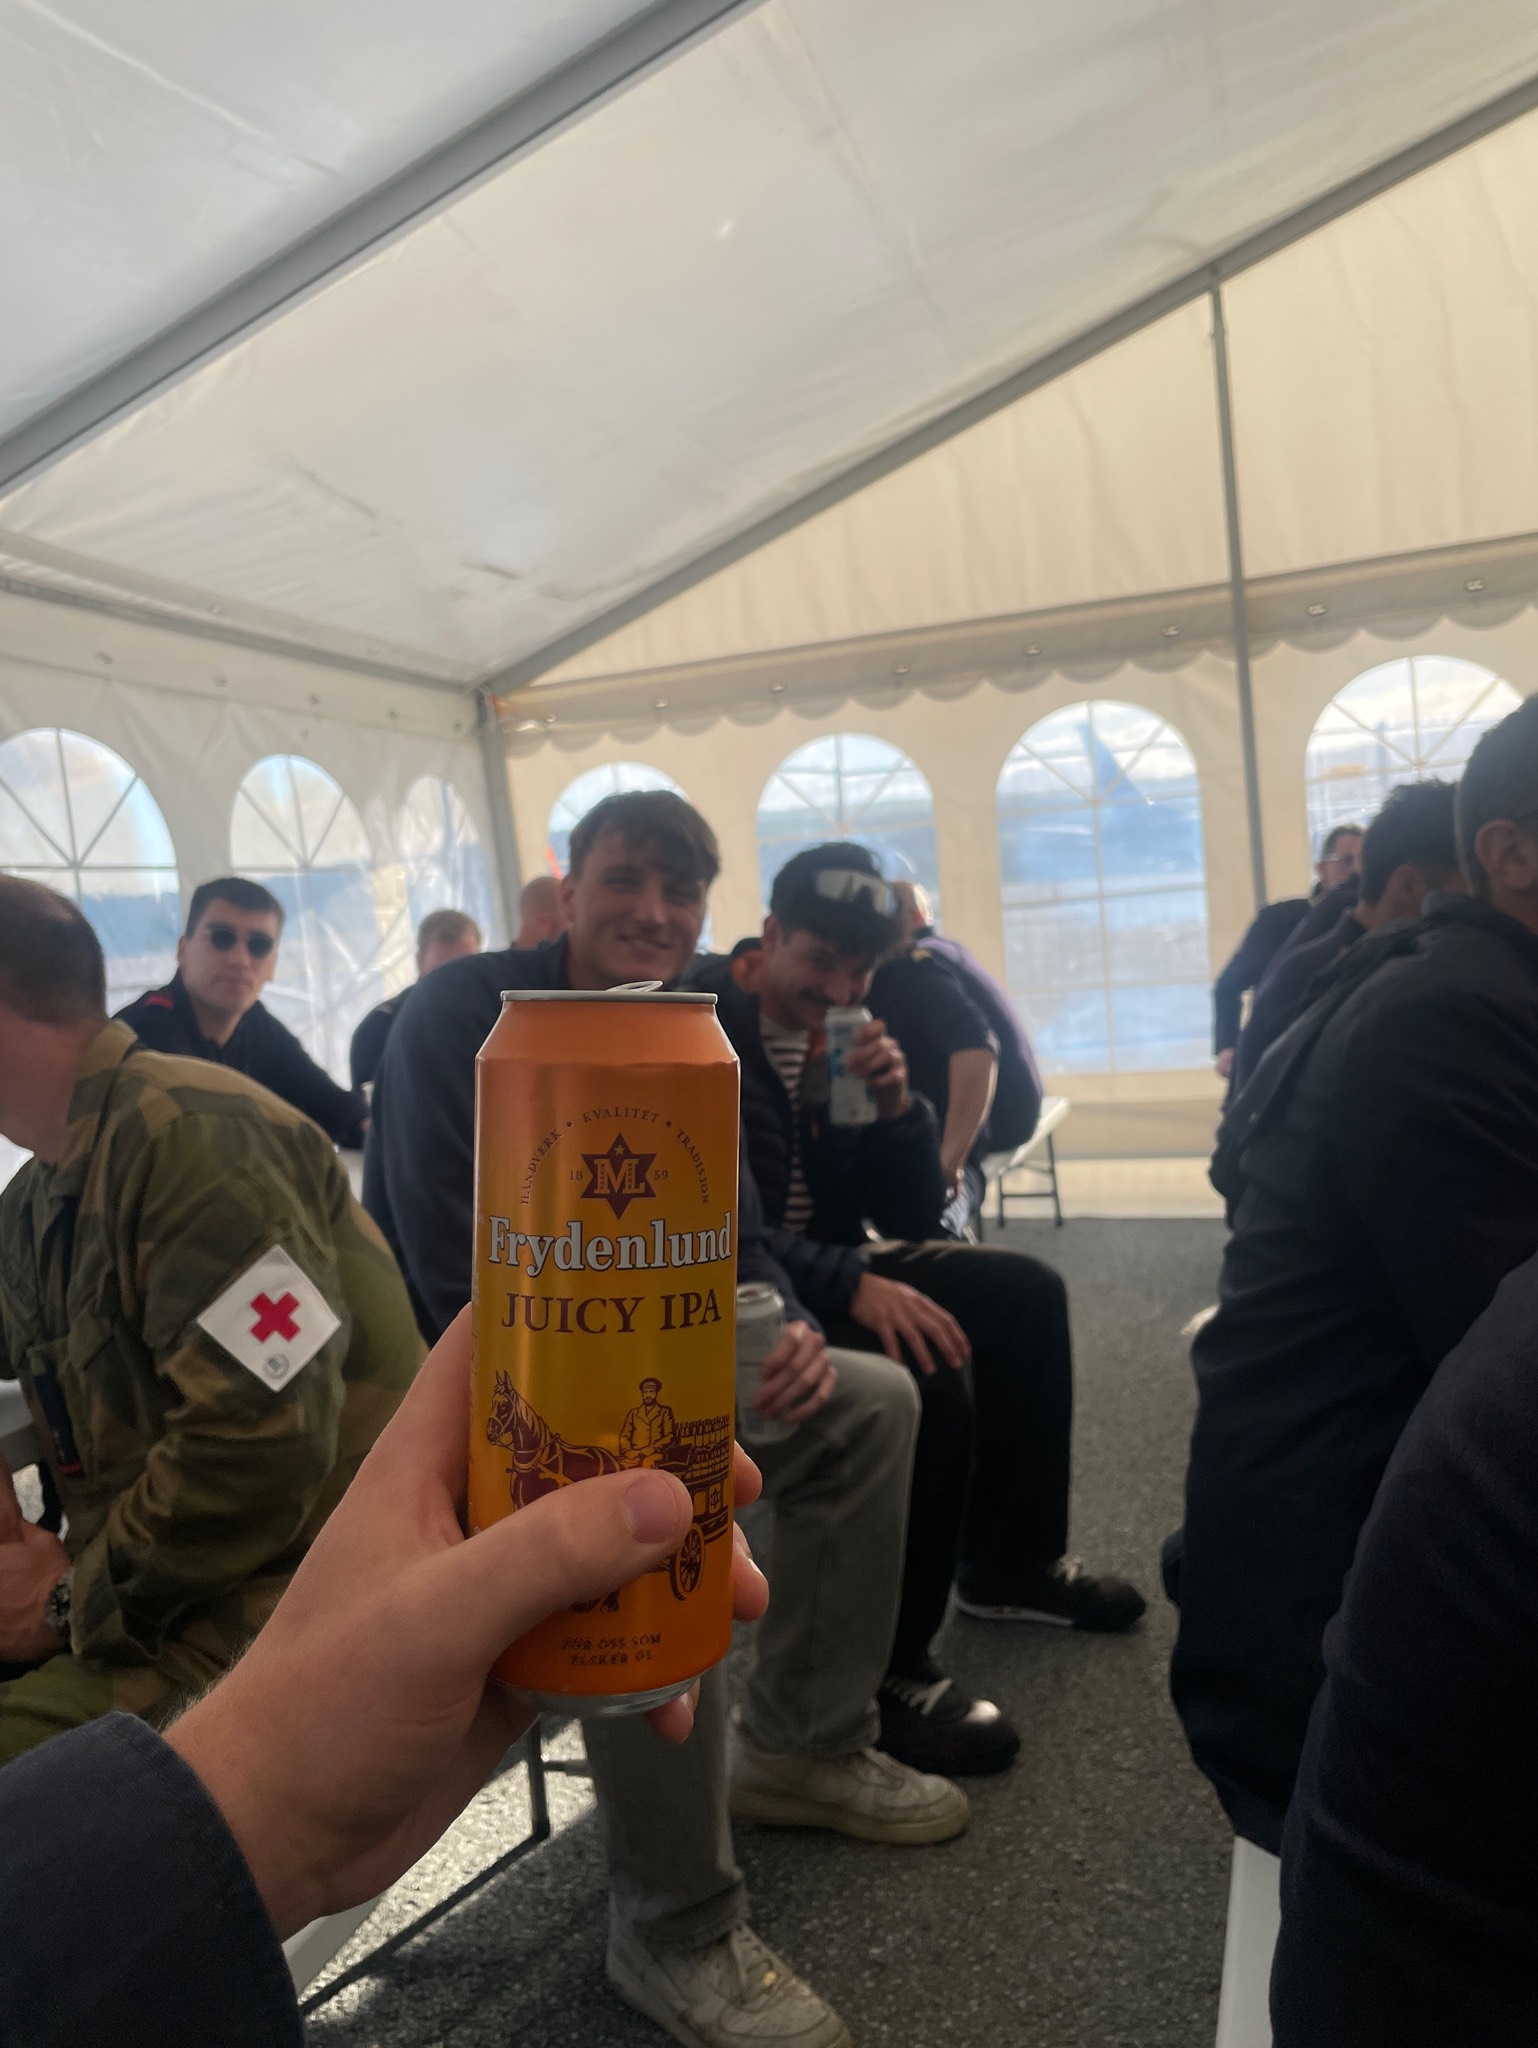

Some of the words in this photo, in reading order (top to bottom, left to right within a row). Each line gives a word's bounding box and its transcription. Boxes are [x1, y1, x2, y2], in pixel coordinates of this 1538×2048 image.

[570, 1170, 583, 1181] 18
[654, 1169, 668, 1180] 59
[583, 1106, 660, 1124] KVALITET
[677, 1129, 710, 1204] TRADISJON
[488, 1211, 732, 1278] Frydenlund
[501, 1292, 646, 1334] JUICY
[660, 1288, 722, 1330] IPA
